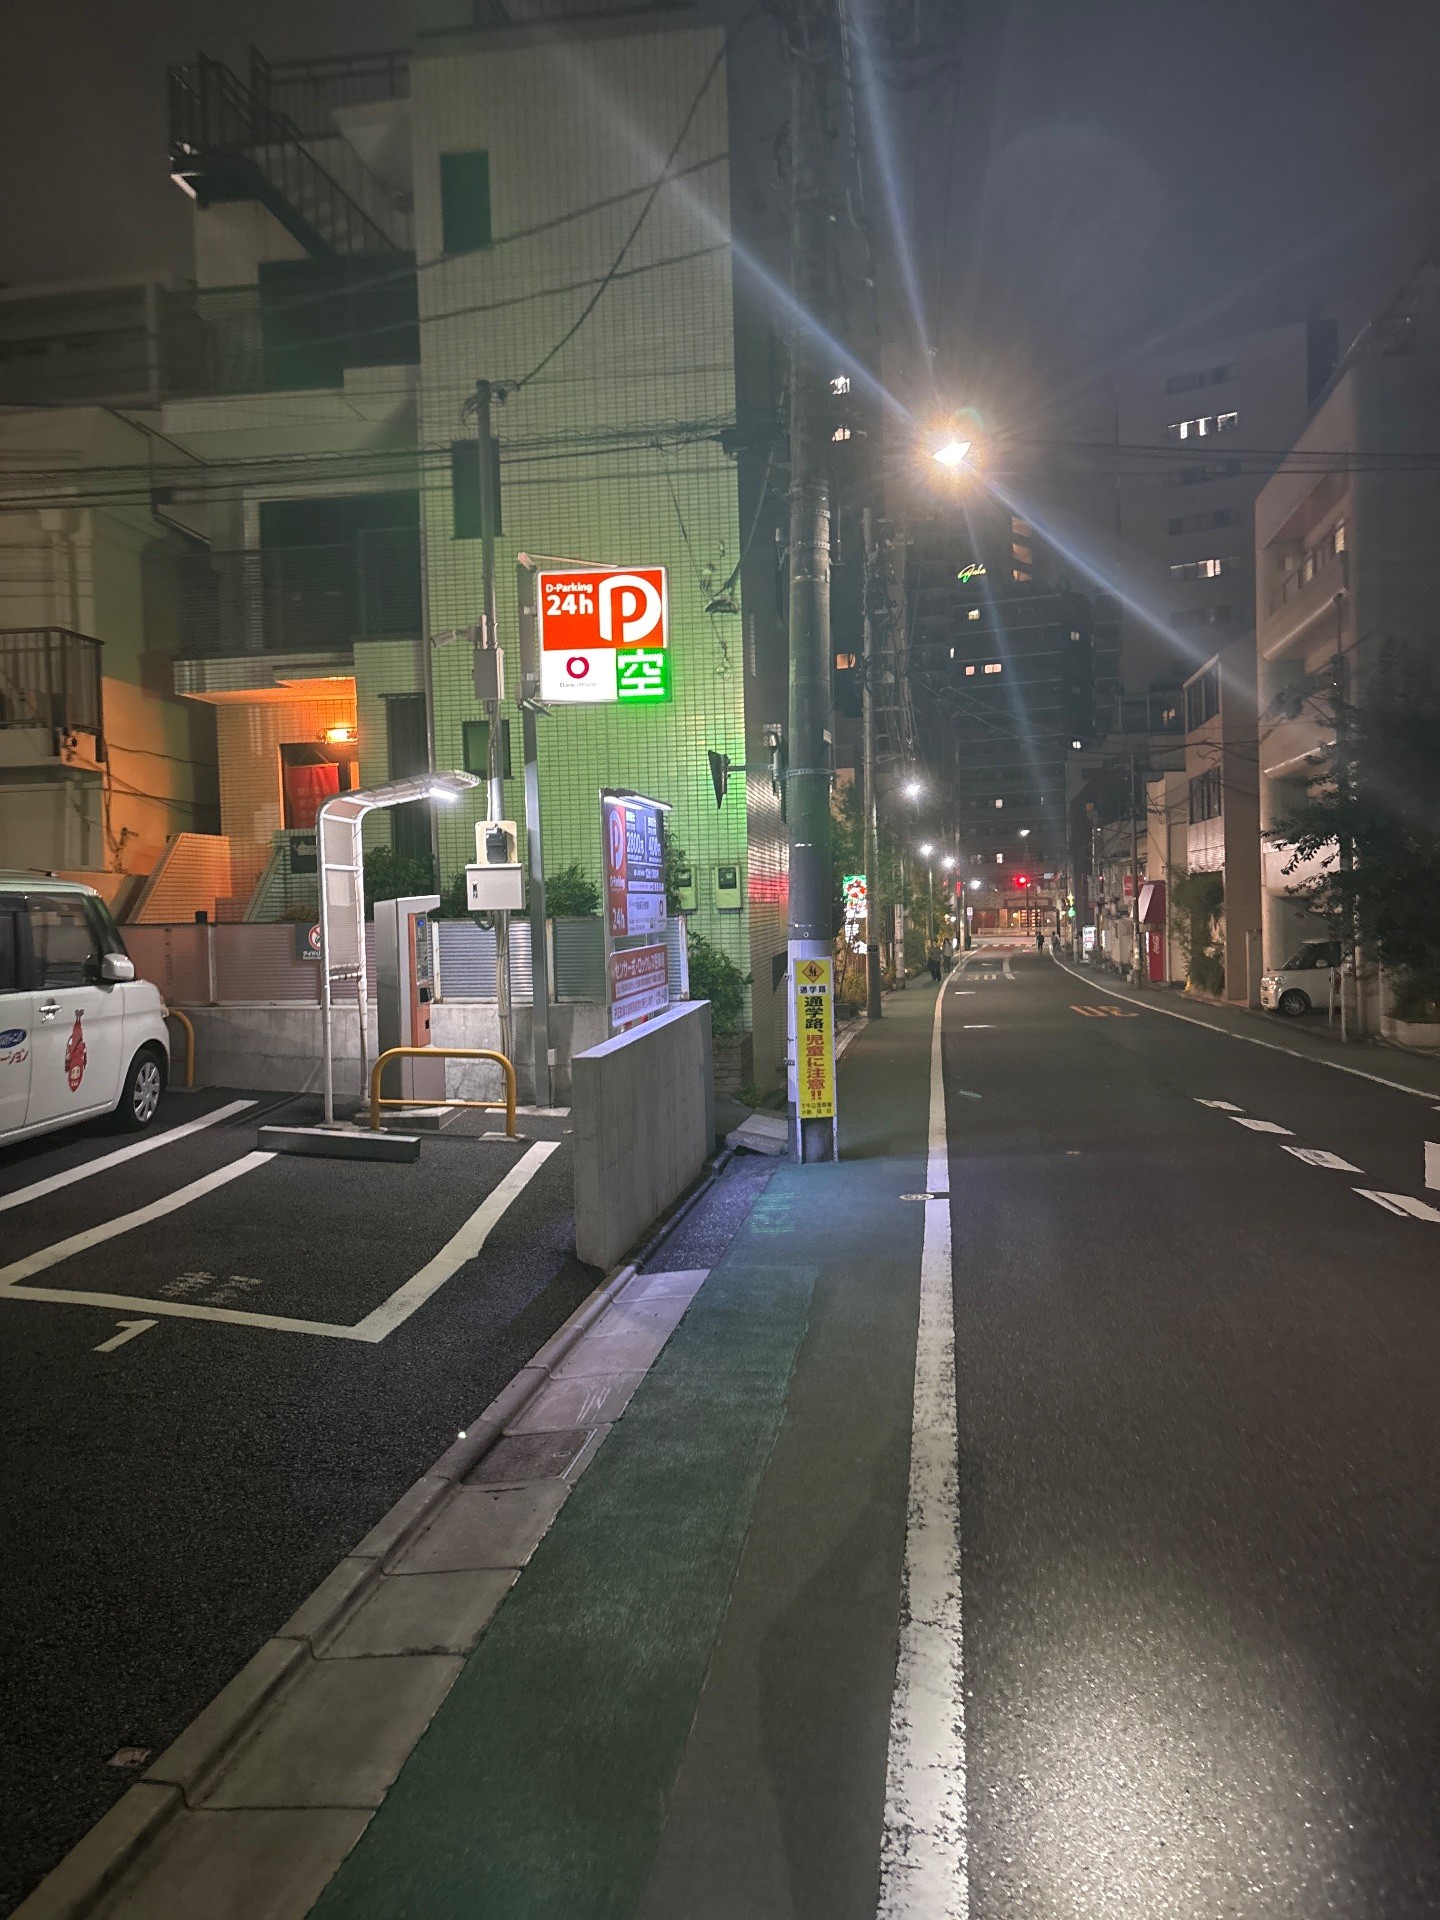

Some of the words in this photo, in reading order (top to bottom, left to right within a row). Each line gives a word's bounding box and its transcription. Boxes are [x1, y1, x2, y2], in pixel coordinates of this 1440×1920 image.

[545, 582, 593, 593] D-Parking
[546, 594, 593, 615] 24h
[599, 575, 661, 642] P
[618, 649, 664, 696] 空
[612, 907, 625, 930] 24h
[800, 985, 827, 994] 通学路
